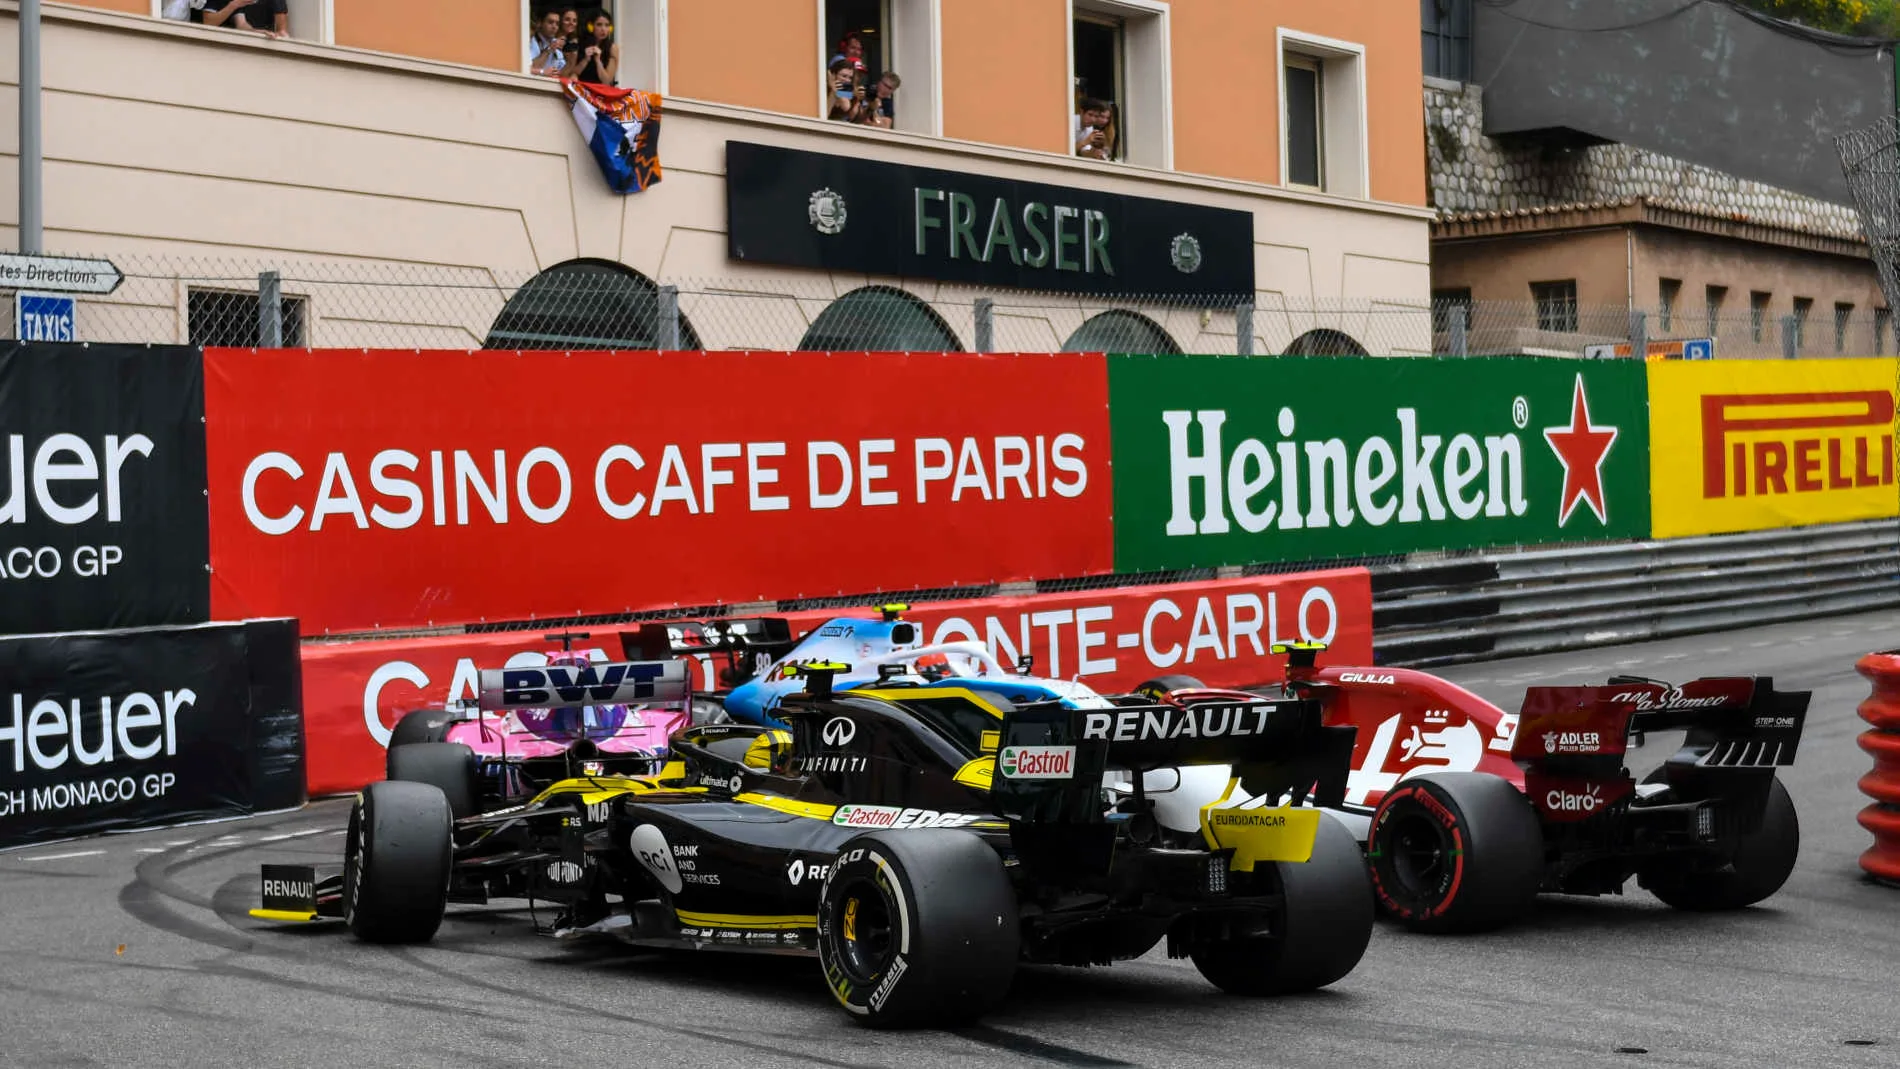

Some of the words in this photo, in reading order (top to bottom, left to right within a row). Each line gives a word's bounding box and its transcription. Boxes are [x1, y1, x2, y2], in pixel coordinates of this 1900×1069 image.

[914, 186, 1116, 276] FRASER
[27, 264, 97, 284] Directions
[24, 314, 70, 341] TAXIS
[1700, 390, 1894, 499] PIRELLI
[1162, 407, 1528, 536] Heineken
[242, 446, 572, 536] CASINO
[595, 442, 790, 520] CAFE
[807, 439, 898, 509] DE
[915, 432, 1089, 503] PARIS
[0, 546, 61, 578] CO
[73, 546, 122, 576] GP
[503, 663, 665, 705] BWT
[1339, 673, 1395, 685] GIULIA
[1083, 706, 1277, 741] RENAULT
[1559, 732, 1600, 745] ADLER
[800, 757, 867, 772] INFINITI
[1018, 751, 1070, 774] Castrol
[33, 776, 136, 810] MONACO
[143, 773, 175, 798] GP
[1547, 787, 1599, 811] Claro
[848, 808, 897, 826] Castrol
[897, 808, 981, 828] EDGE
[1215, 814, 1286, 827] EURODATACAR
[673, 845, 698, 856] BANK
[679, 860, 695, 871] AND
[264, 879, 313, 899] RENAULT
